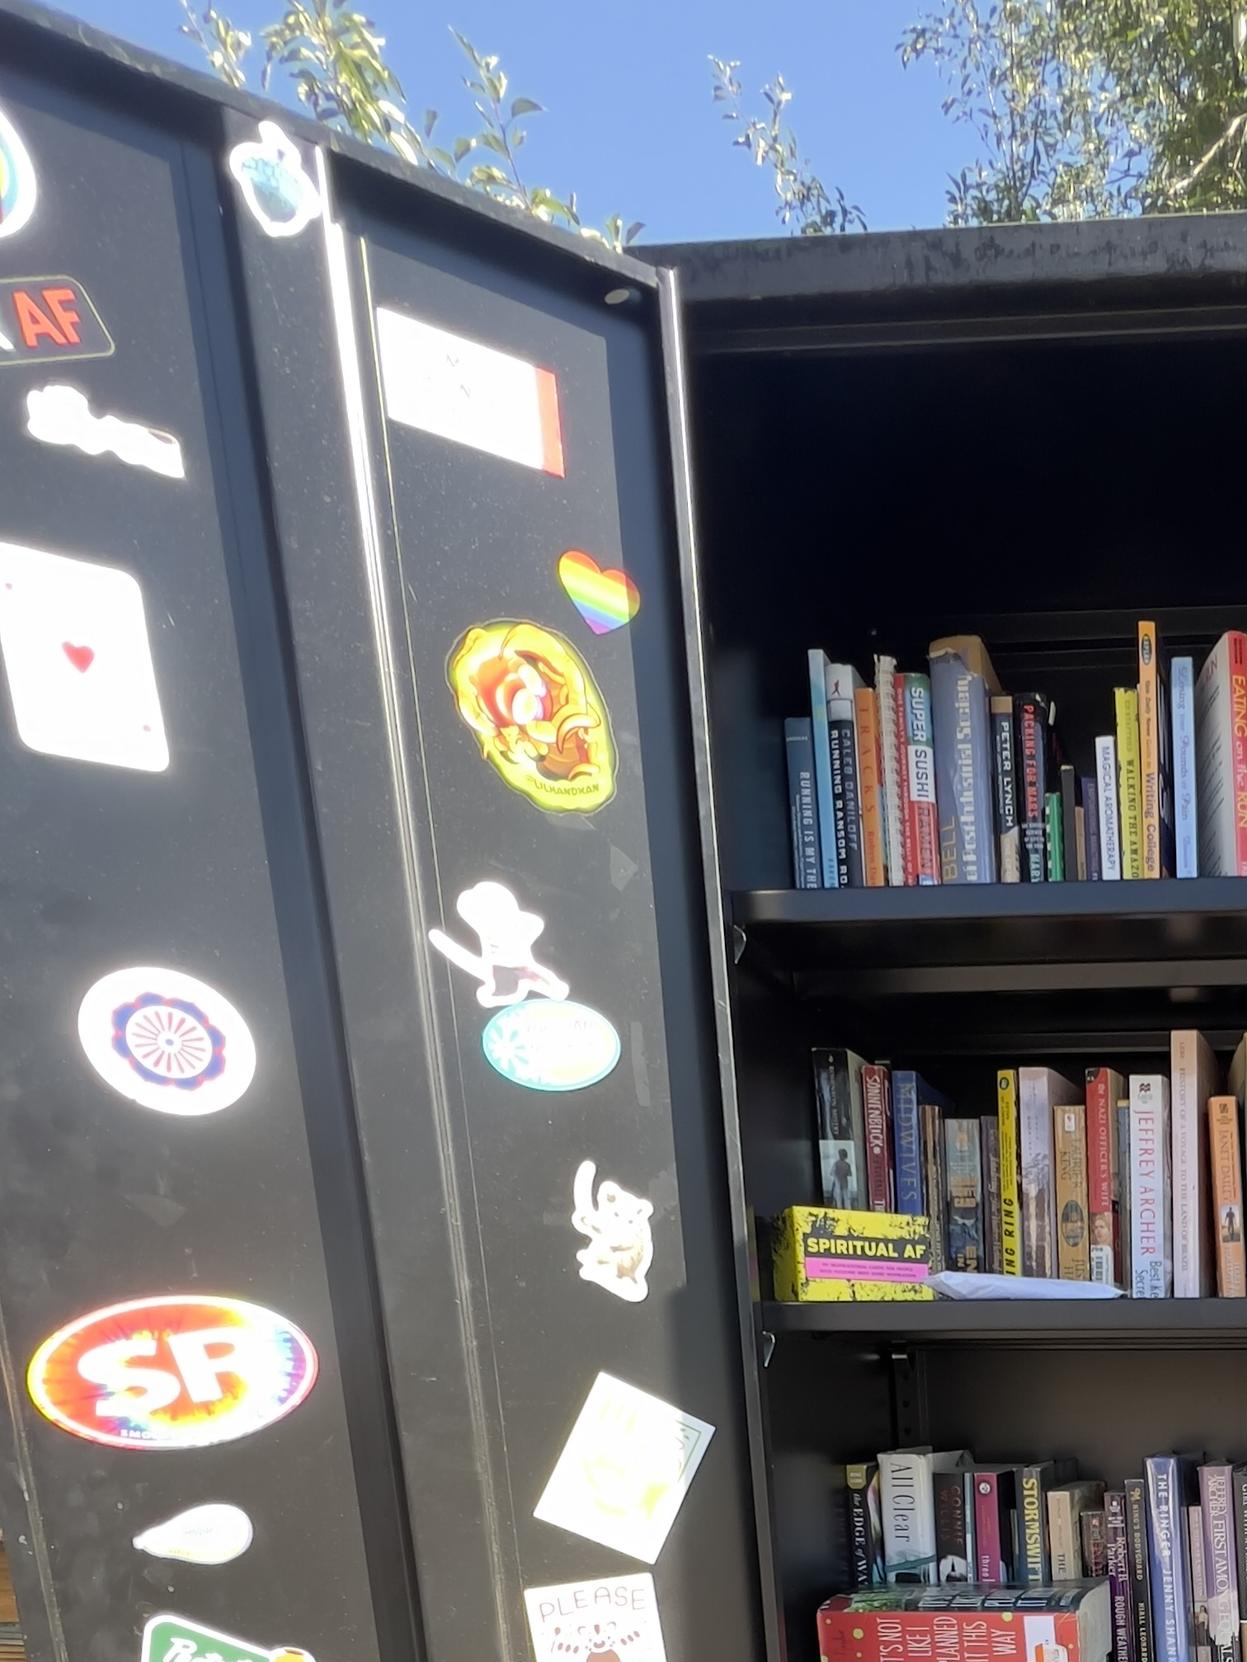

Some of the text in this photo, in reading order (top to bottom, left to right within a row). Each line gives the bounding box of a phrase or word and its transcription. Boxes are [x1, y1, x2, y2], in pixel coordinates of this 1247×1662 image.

[12, 287, 80, 348] AF
[910, 687, 928, 741] SUPER
[1232, 675, 1247, 738] EATING
[842, 730, 853, 774] CALEB
[1023, 705, 1036, 755] PACKING
[1236, 741, 1246, 759] on
[915, 749, 930, 798] SUSHI
[1000, 722, 1014, 826] PETER LYNCH
[1026, 760, 1037, 781] FOR
[1101, 746, 1113, 792] MAGICAL
[831, 730, 846, 859] RUNNING RANSOM
[1028, 787, 1039, 818] MARS
[1126, 759, 1139, 836] WALKING THE
[800, 772, 817, 864] RUNNING IS MY
[1145, 772, 1158, 871] Writing College
[942, 816, 958, 880] BELL
[897, 1083, 918, 1201] MIDWIVES
[1099, 1098, 1109, 1207] NAZI WIFE
[1134, 1110, 1157, 1257] JEFFREY ARCHER
[1003, 1198, 1015, 1238] RING
[807, 1236, 926, 1260] SPIRITUAL AF
[1149, 1261, 1162, 1282] Best
[890, 1463, 916, 1544] All Clear
[1157, 1473, 1171, 1556] THE RINGER
[853, 1507, 865, 1546] EDGE
[1022, 1477, 1042, 1582] STORMSWIFT
[1212, 1519, 1228, 1555] FIRST
[1107, 1543, 1118, 1577] Parker
[1116, 1537, 1128, 1573] Robert
[1134, 1532, 1143, 1580] BODYGUARD
[539, 1587, 645, 1623] PLEASE
[1114, 1596, 1127, 1626] ROUGH
[1163, 1569, 1174, 1611] JENNY
[877, 1617, 902, 1641] NOT
[906, 1634, 931, 1656] LIKE
[962, 1620, 989, 1662] IT THIS
[991, 1628, 1017, 1655] WAY
[1139, 1628, 1148, 1662] LEONARD
